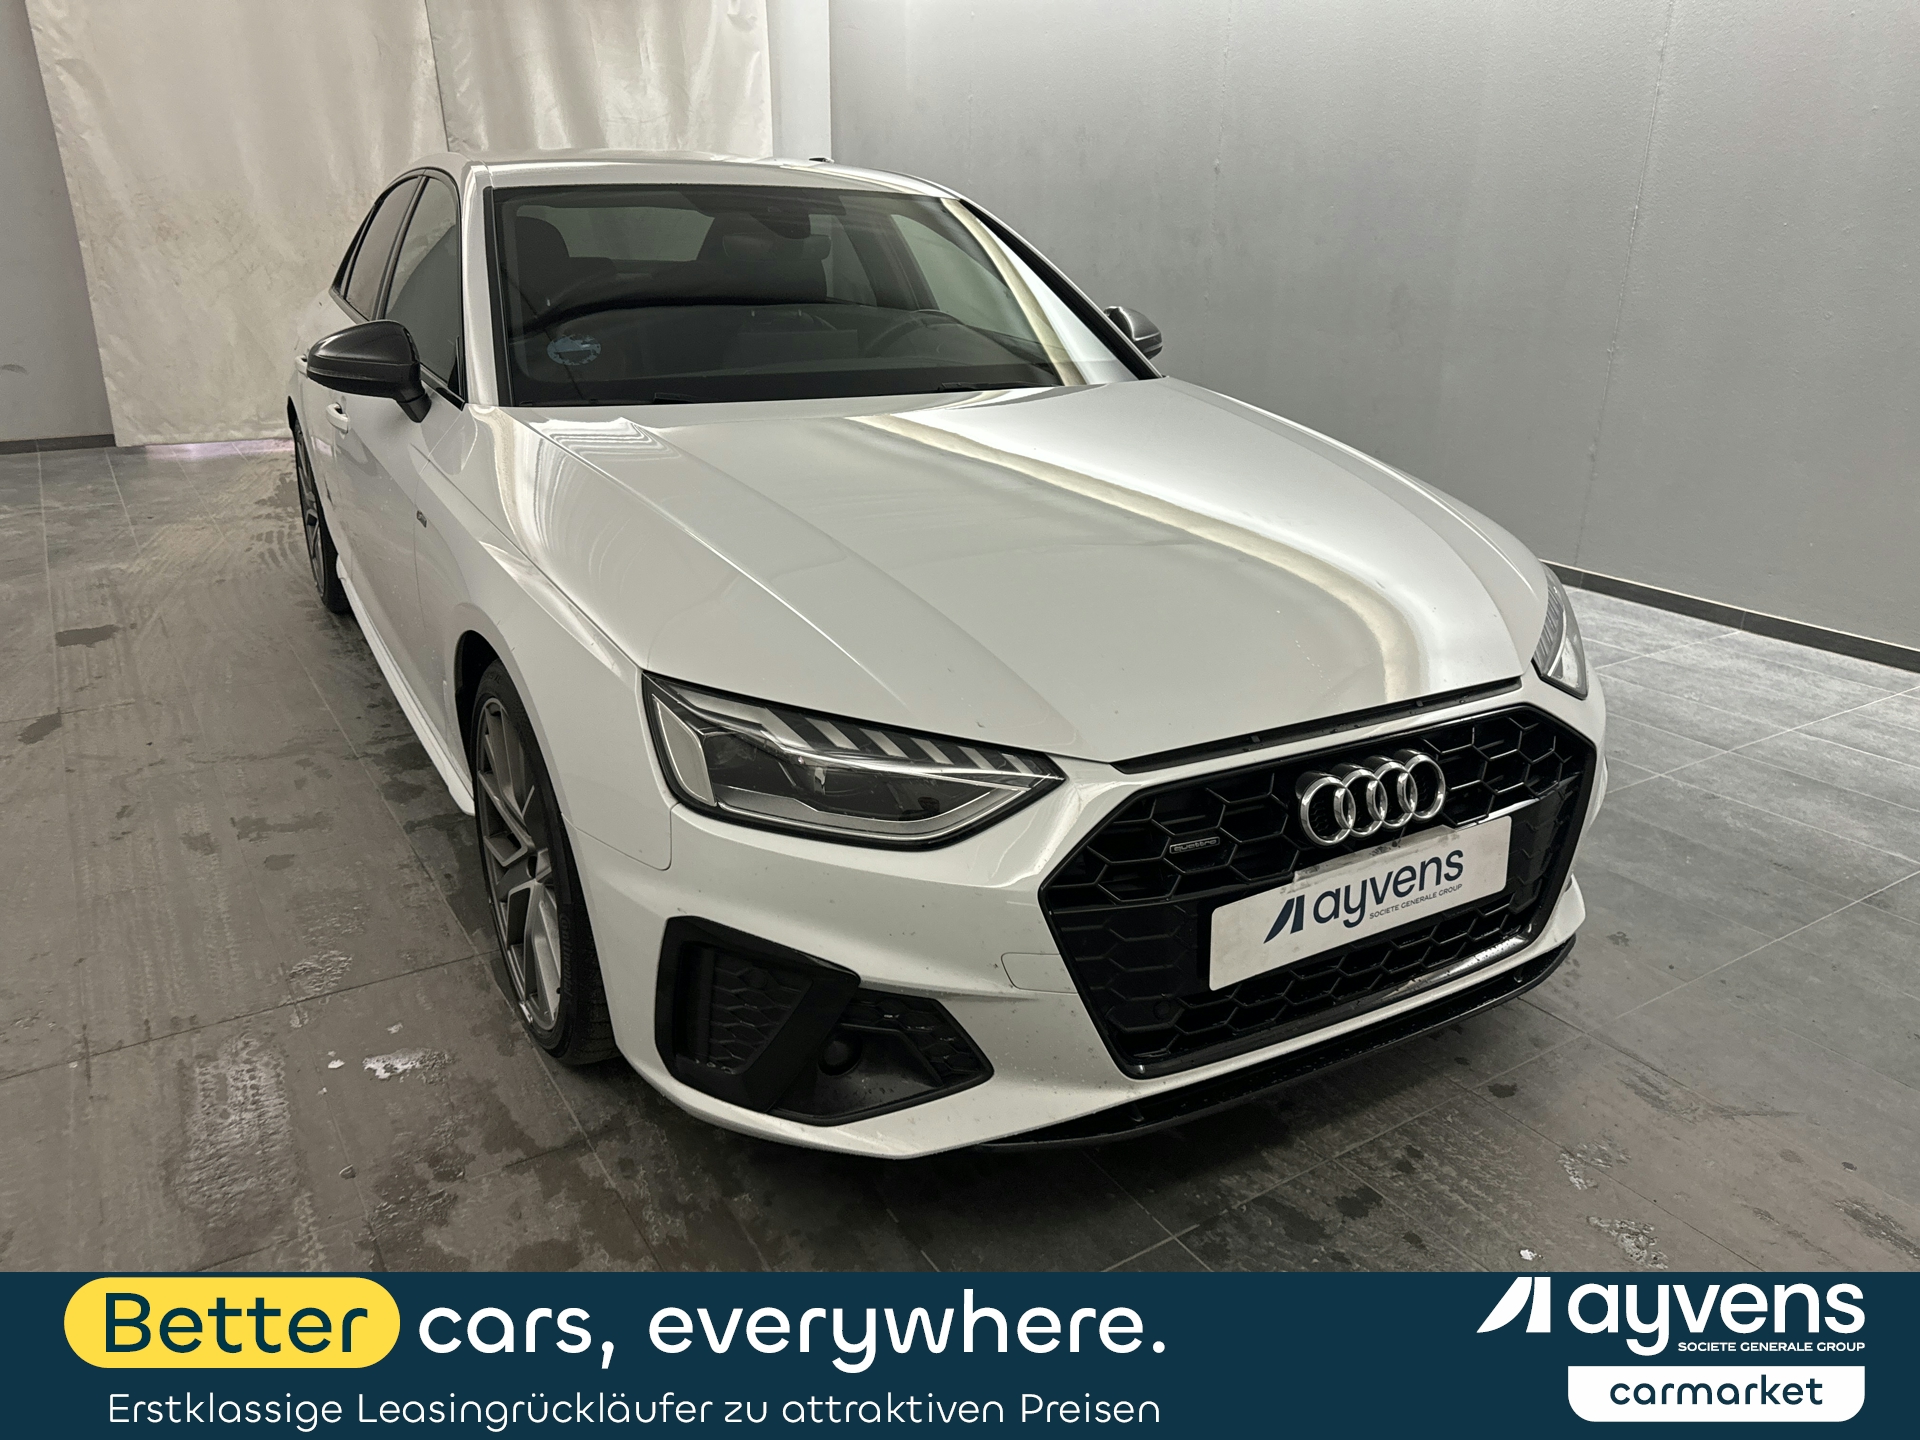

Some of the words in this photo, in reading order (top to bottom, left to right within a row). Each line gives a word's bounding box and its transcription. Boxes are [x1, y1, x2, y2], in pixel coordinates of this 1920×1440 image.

[1173, 839, 1217, 852] quattro
[1313, 849, 1464, 928] ayvens
[1369, 904, 1400, 919] SOCIETE
[1401, 891, 1437, 909] GENERALE
[1438, 883, 1463, 897] GROUP
[560, 914, 573, 995] Continental
